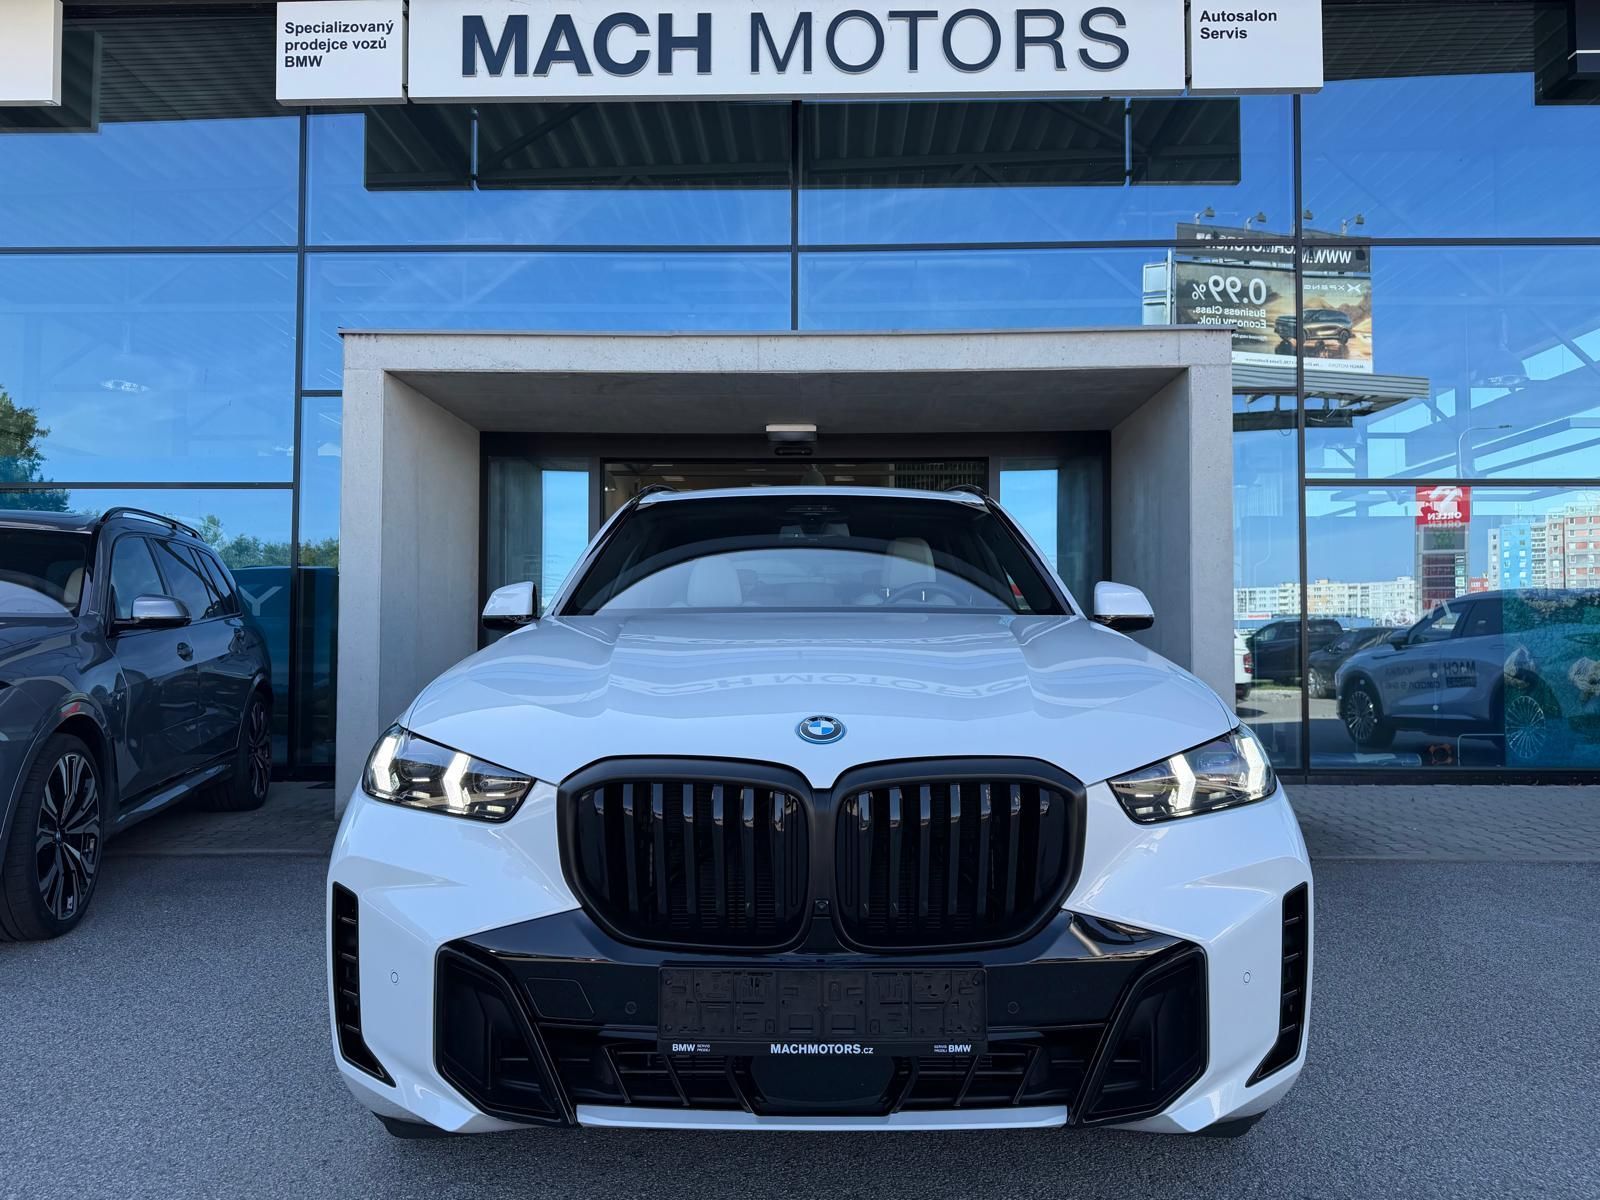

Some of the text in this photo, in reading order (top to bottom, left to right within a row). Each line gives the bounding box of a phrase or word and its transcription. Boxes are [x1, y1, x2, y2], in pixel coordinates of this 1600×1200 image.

[1200, 10, 1277, 22] Autosalon
[284, 20, 394, 36] Specializovaný
[1200, 27, 1248, 39] Servis
[284, 36, 387, 53] prodejce vozů
[462, 7, 1130, 77] MACH MOTORS
[284, 55, 323, 68] BMW
[672, 1043, 696, 1052] BMW
[770, 1043, 874, 1055] MACHMOTORS.cz
[948, 1044, 972, 1053] BMW
